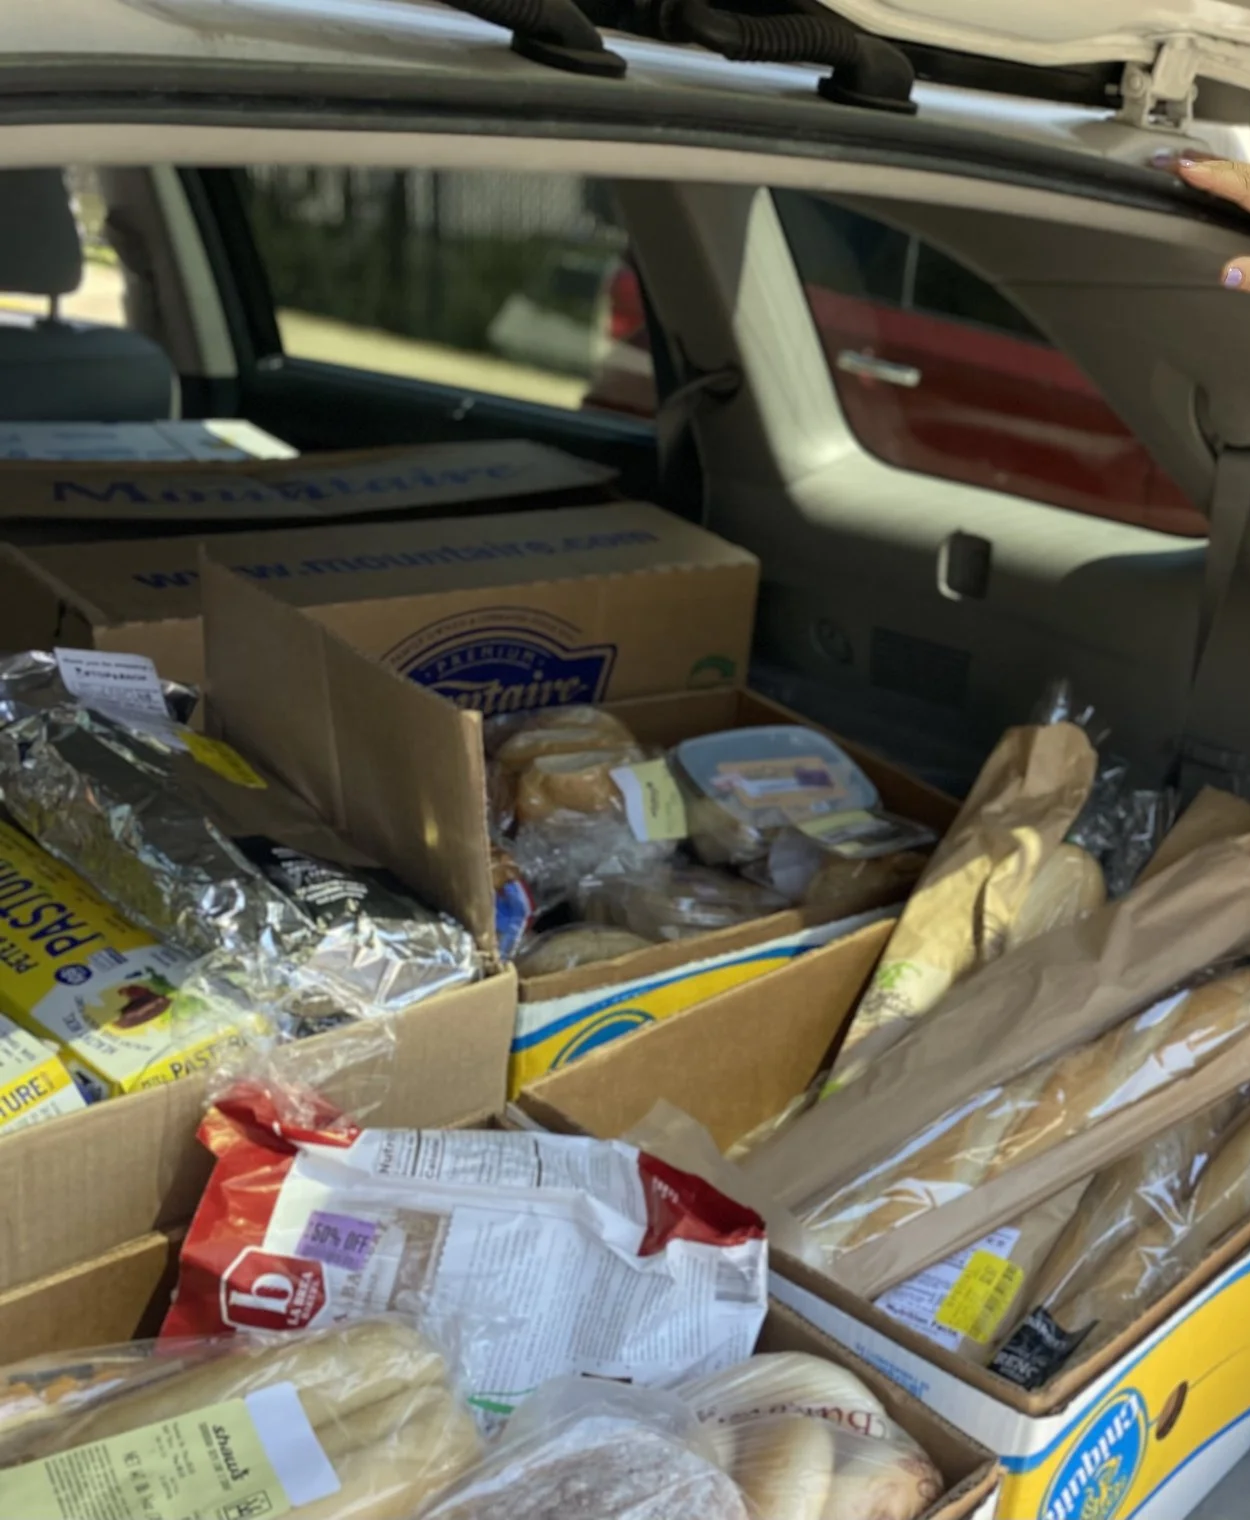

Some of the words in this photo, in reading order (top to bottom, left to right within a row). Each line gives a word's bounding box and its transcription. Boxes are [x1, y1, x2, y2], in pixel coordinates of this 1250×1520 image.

[436, 645, 537, 674] PREMIUM
[311, 1222, 342, 1248] 50%
[343, 1230, 370, 1254] OFF
